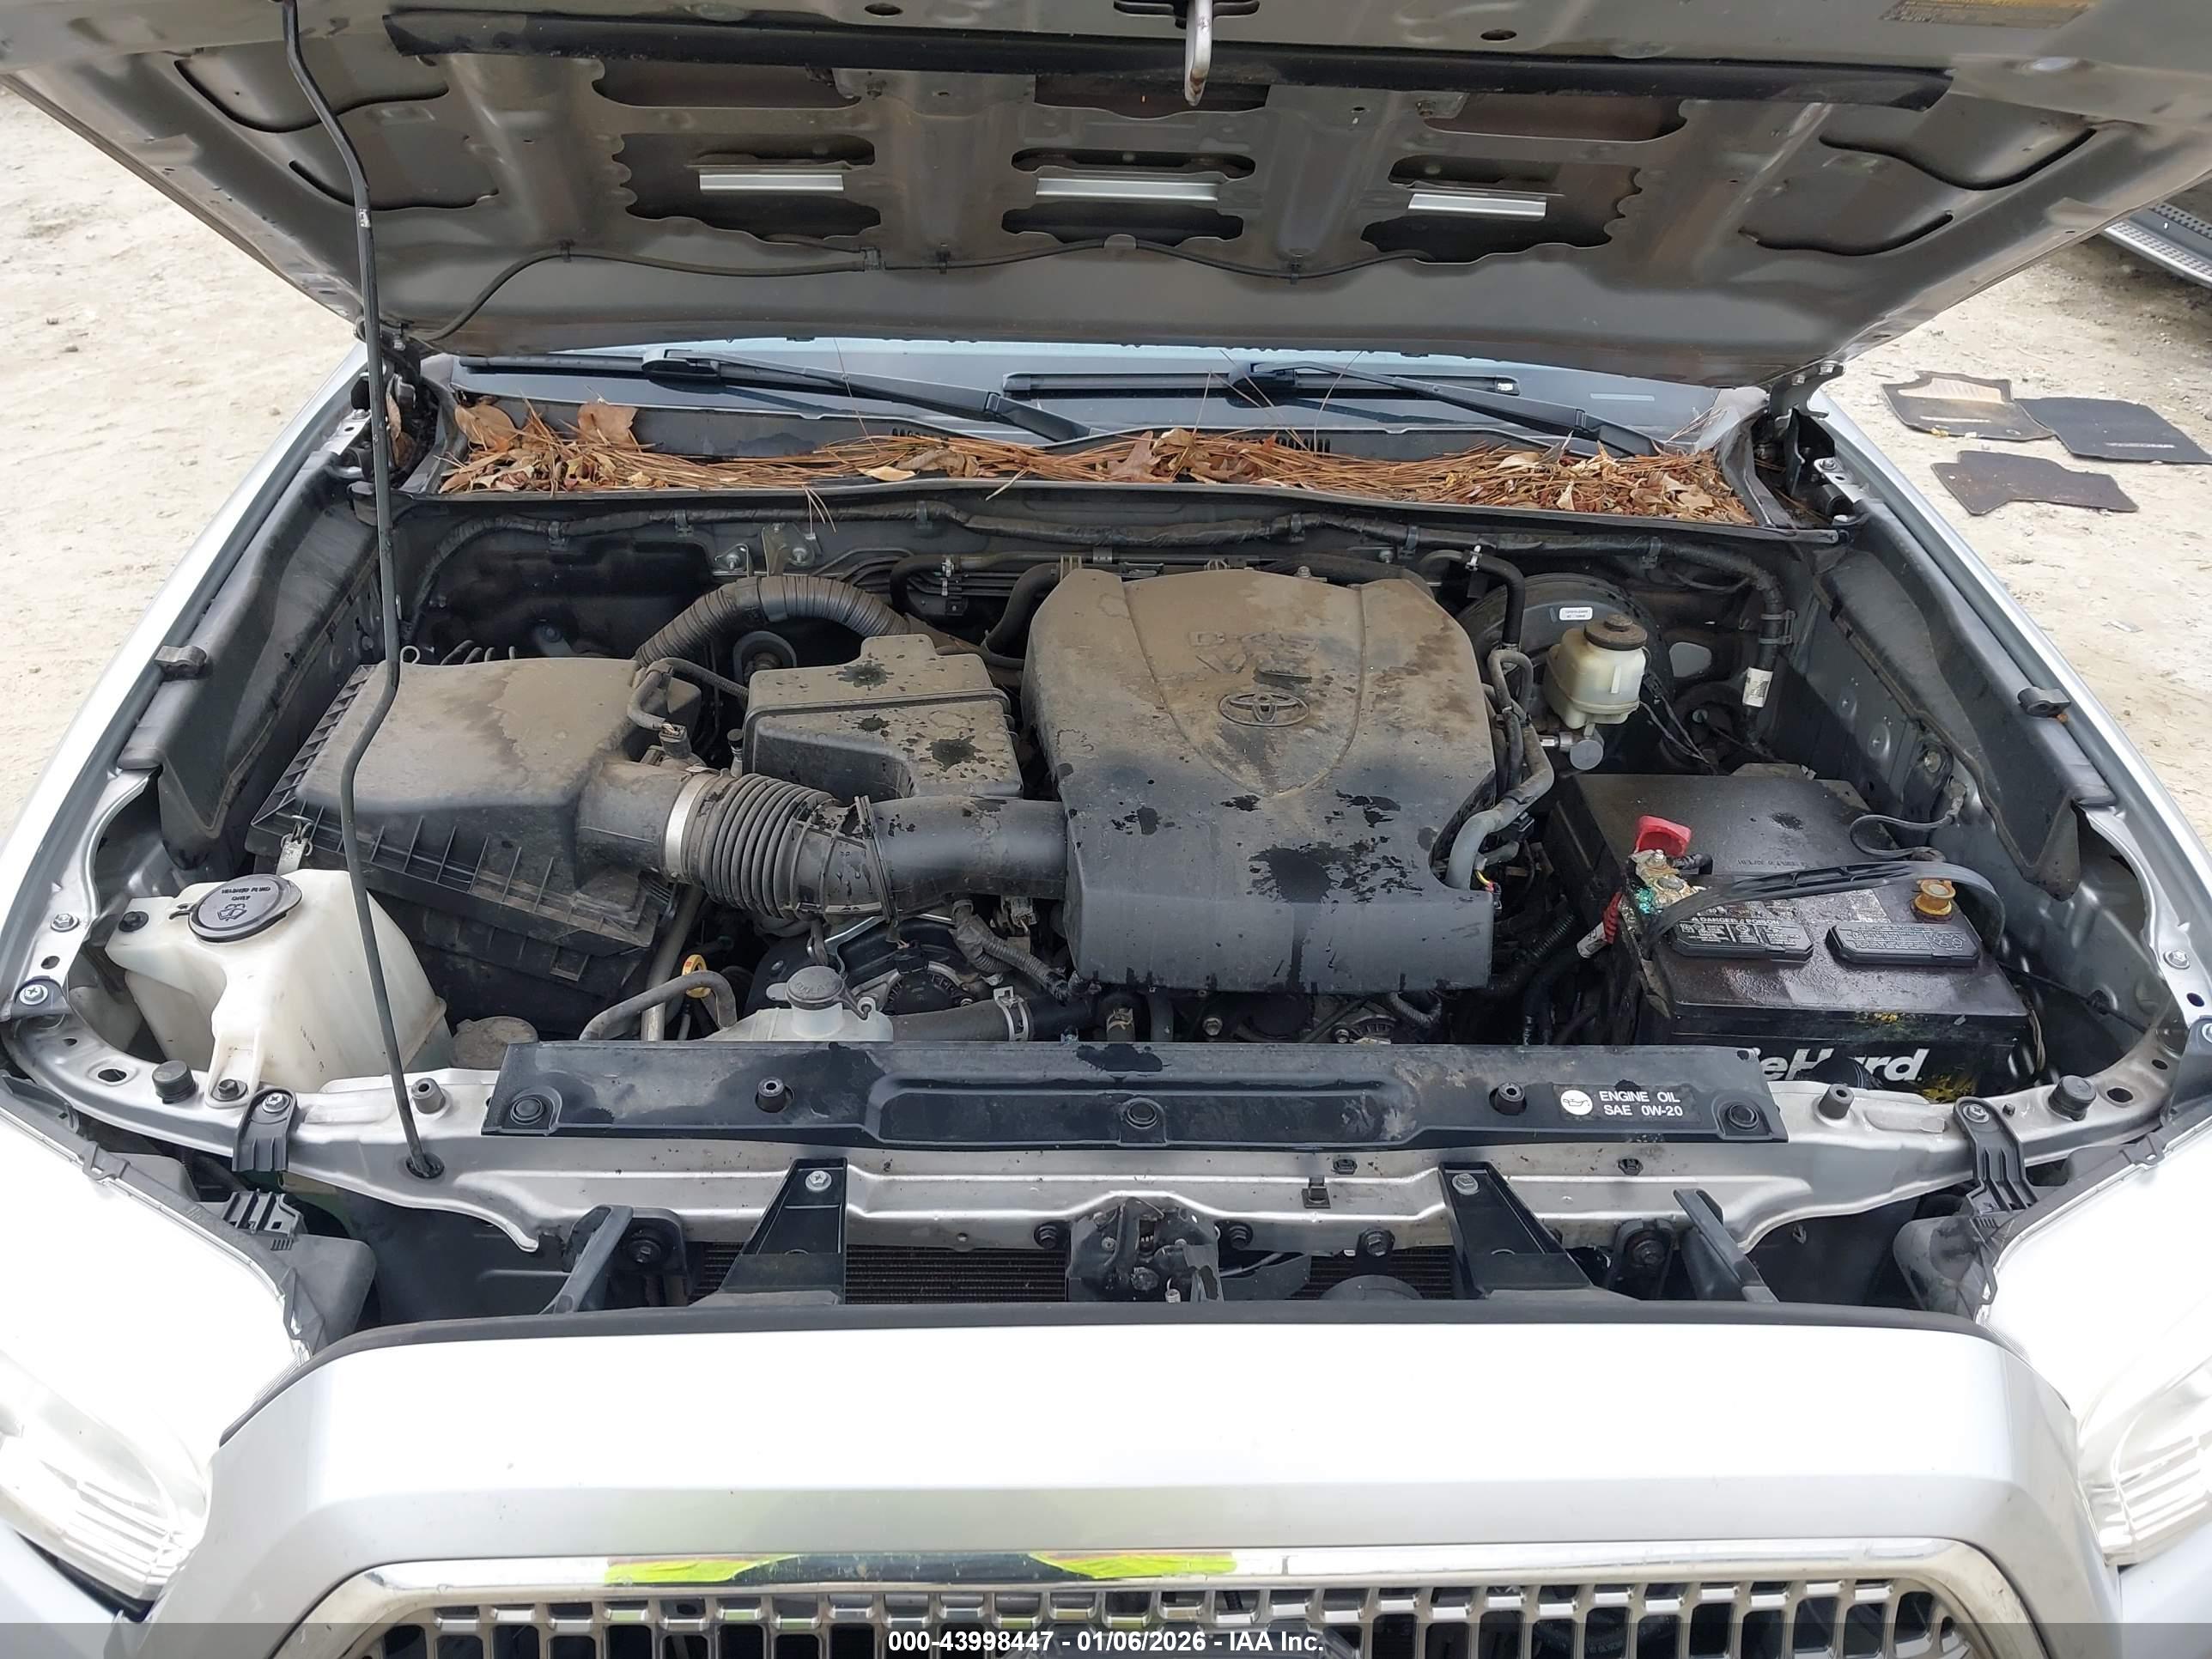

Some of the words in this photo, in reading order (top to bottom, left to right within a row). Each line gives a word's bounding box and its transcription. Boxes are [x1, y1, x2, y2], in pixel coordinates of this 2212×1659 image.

[1599, 1091, 1650, 1103] ENGINE
[1656, 1091, 1680, 1103] OIL
[1603, 1104, 1633, 1115] SAE
[1641, 1105, 1683, 1116] 0W-20
